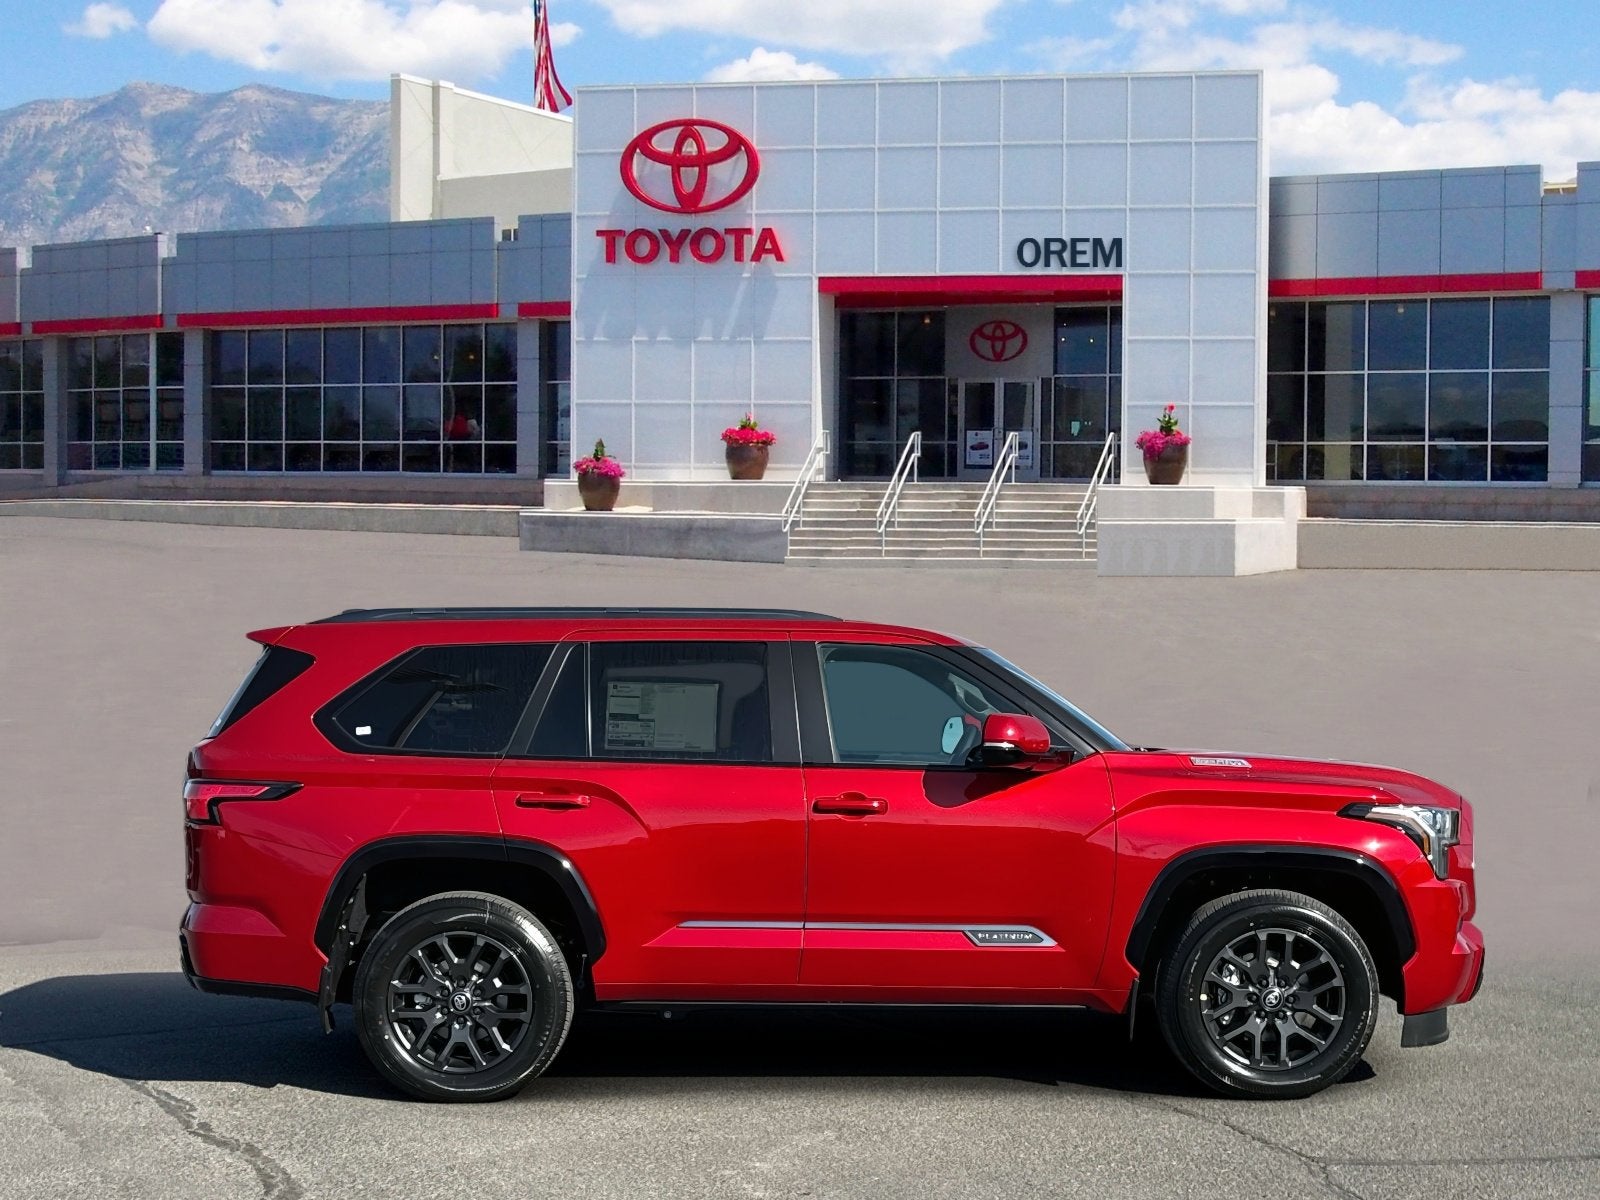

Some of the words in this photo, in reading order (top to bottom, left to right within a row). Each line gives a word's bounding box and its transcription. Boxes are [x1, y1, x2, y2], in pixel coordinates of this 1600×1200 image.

[597, 228, 784, 264] TOYOTA
[1017, 237, 1123, 268] OREM
[977, 932, 1033, 941] PLATINUM
